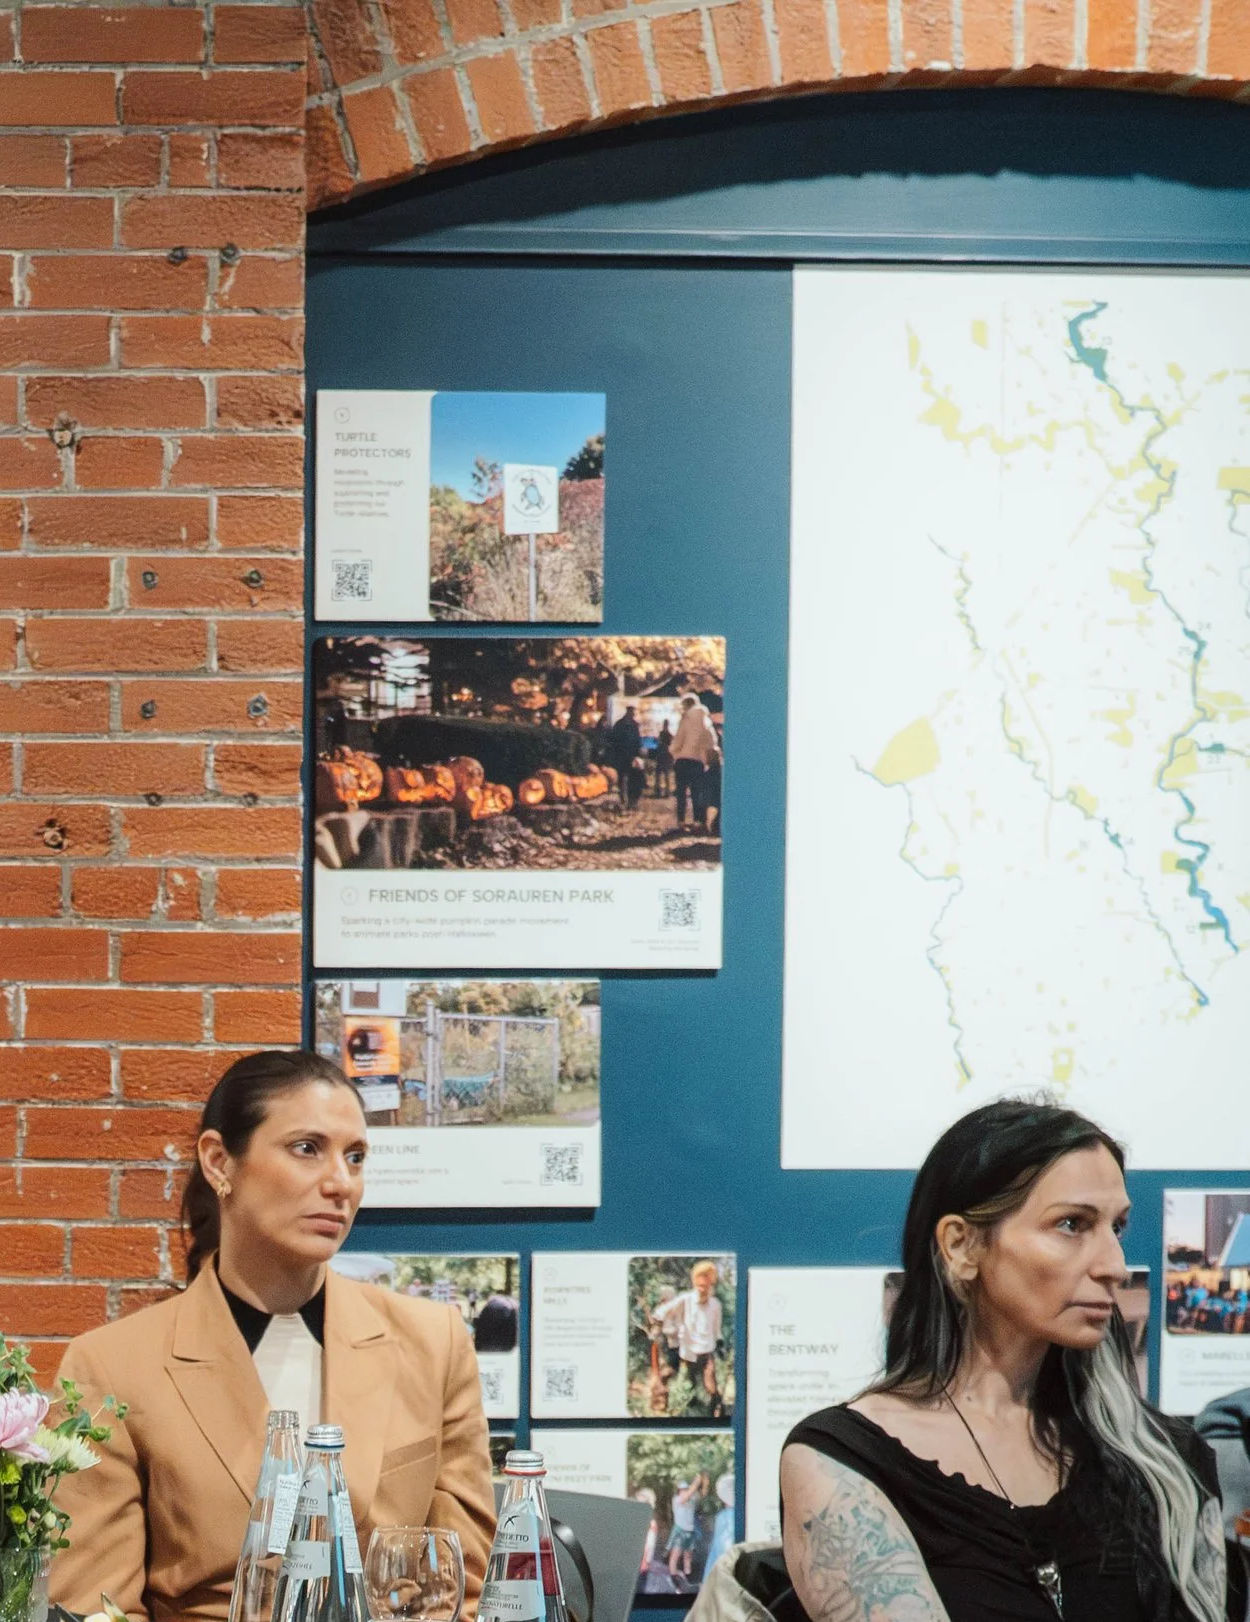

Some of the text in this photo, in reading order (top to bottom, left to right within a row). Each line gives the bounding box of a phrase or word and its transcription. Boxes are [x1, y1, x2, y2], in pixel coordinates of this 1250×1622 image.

[335, 432, 378, 443] TURTLE
[334, 447, 411, 459] PROTECTORS
[369, 888, 615, 904] FRIENDS OF SORAUREN PARK
[371, 1144, 395, 1155] EEN
[769, 1324, 797, 1336] THE
[768, 1343, 839, 1356] BENTWAY
